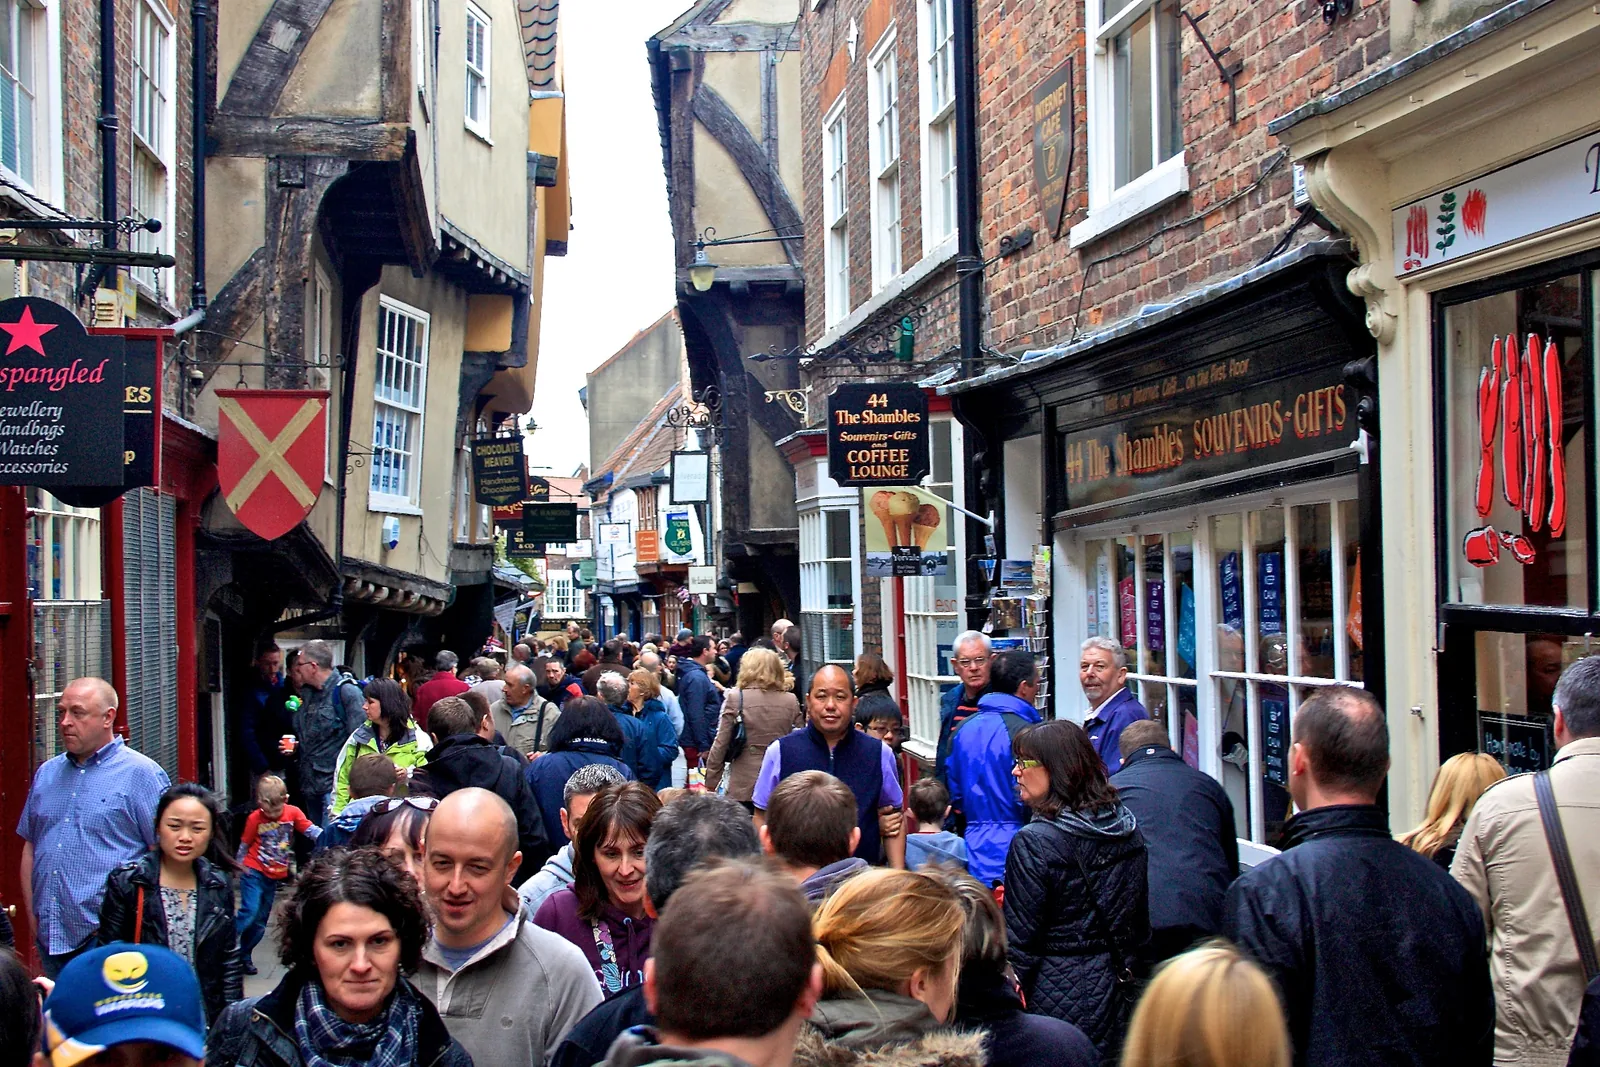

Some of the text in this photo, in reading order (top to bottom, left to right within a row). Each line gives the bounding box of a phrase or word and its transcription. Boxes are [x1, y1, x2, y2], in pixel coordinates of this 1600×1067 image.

[1034, 82, 1067, 123] INTERNET
[0, 358, 110, 392] spangled
[1229, 358, 1250, 377] Floor
[867, 393, 889, 408] 44
[835, 409, 921, 425] The Shambles
[0, 439, 59, 455] Watches
[476, 442, 520, 456] CHOCOLATE
[1066, 441, 1083, 483] 44
[1086, 438, 1110, 481] The
[1115, 423, 1184, 477] Shambles
[484, 455, 514, 468] HEAVEN
[847, 449, 909, 463] COFFEE
[850, 464, 909, 479] LOUNGE
[481, 476, 520, 486] Handmade
[480, 485, 521, 494] Chocolates
